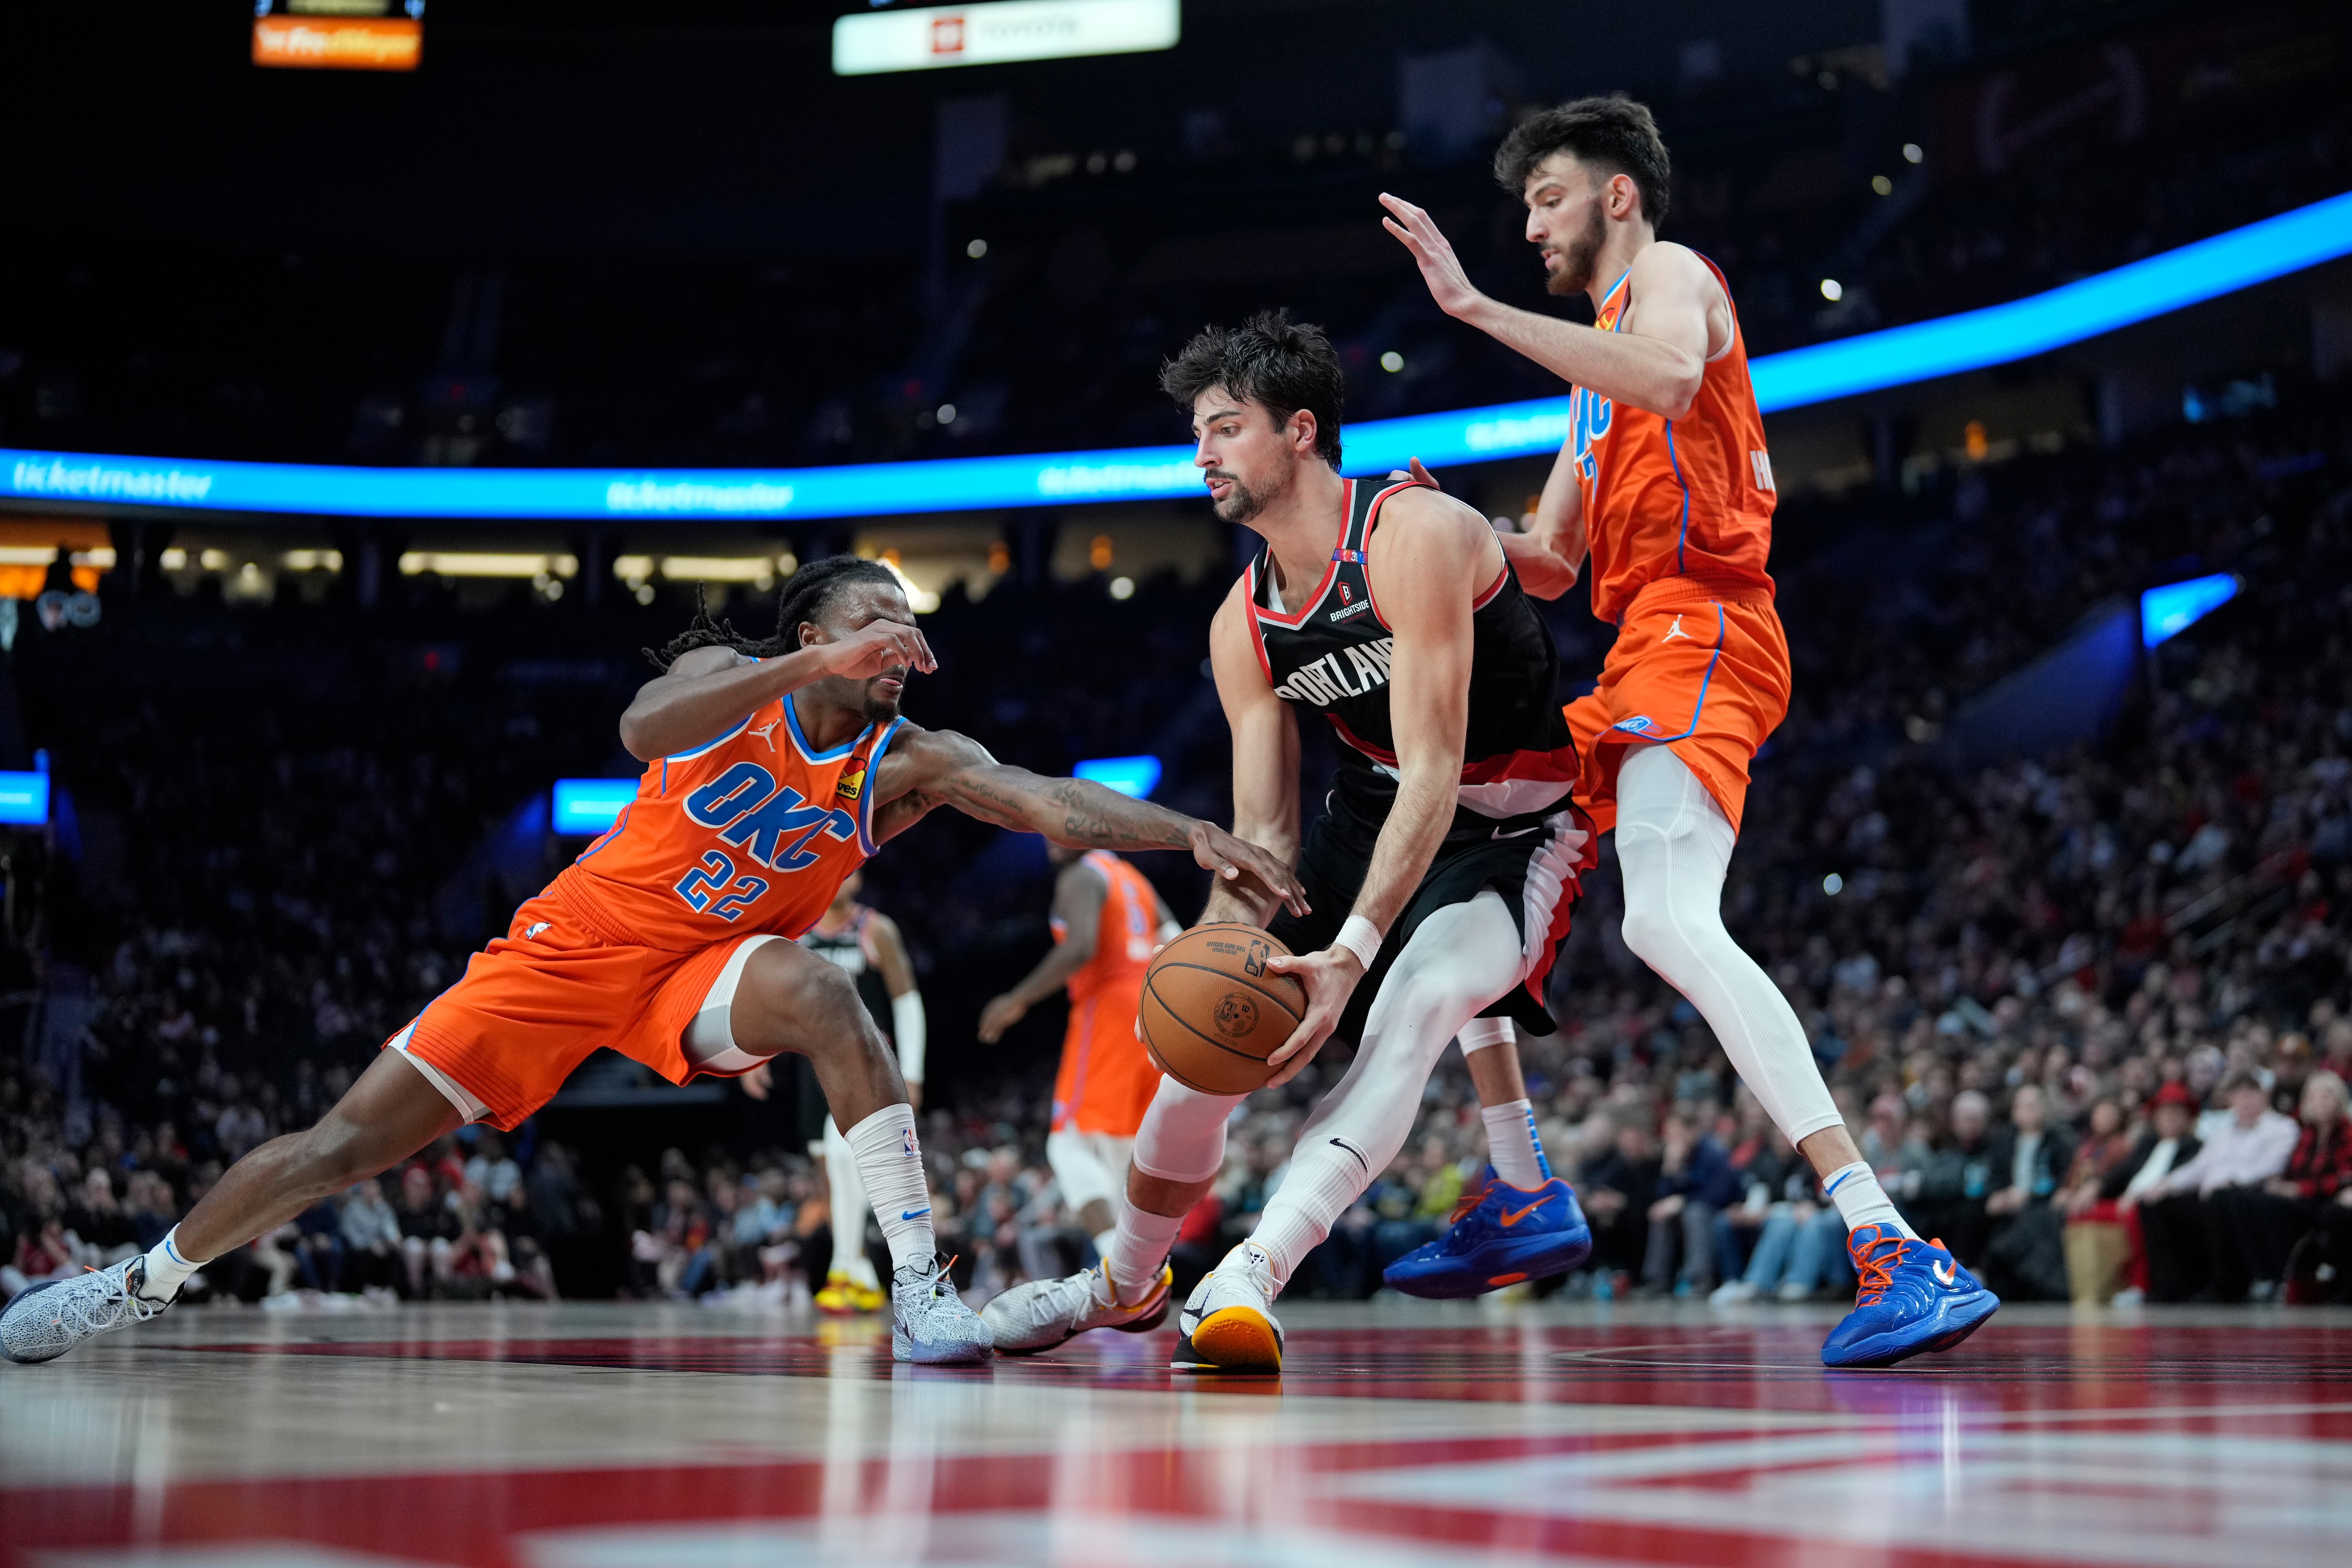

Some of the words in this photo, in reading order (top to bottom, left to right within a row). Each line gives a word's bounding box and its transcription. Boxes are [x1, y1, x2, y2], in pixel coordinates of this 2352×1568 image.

[13, 457, 213, 501] ticketmaster
[1330, 599, 1369, 622] BRIGHTSIDE
[837, 781, 857, 795] ves
[683, 761, 856, 873] OKC
[673, 849, 770, 923] 22
